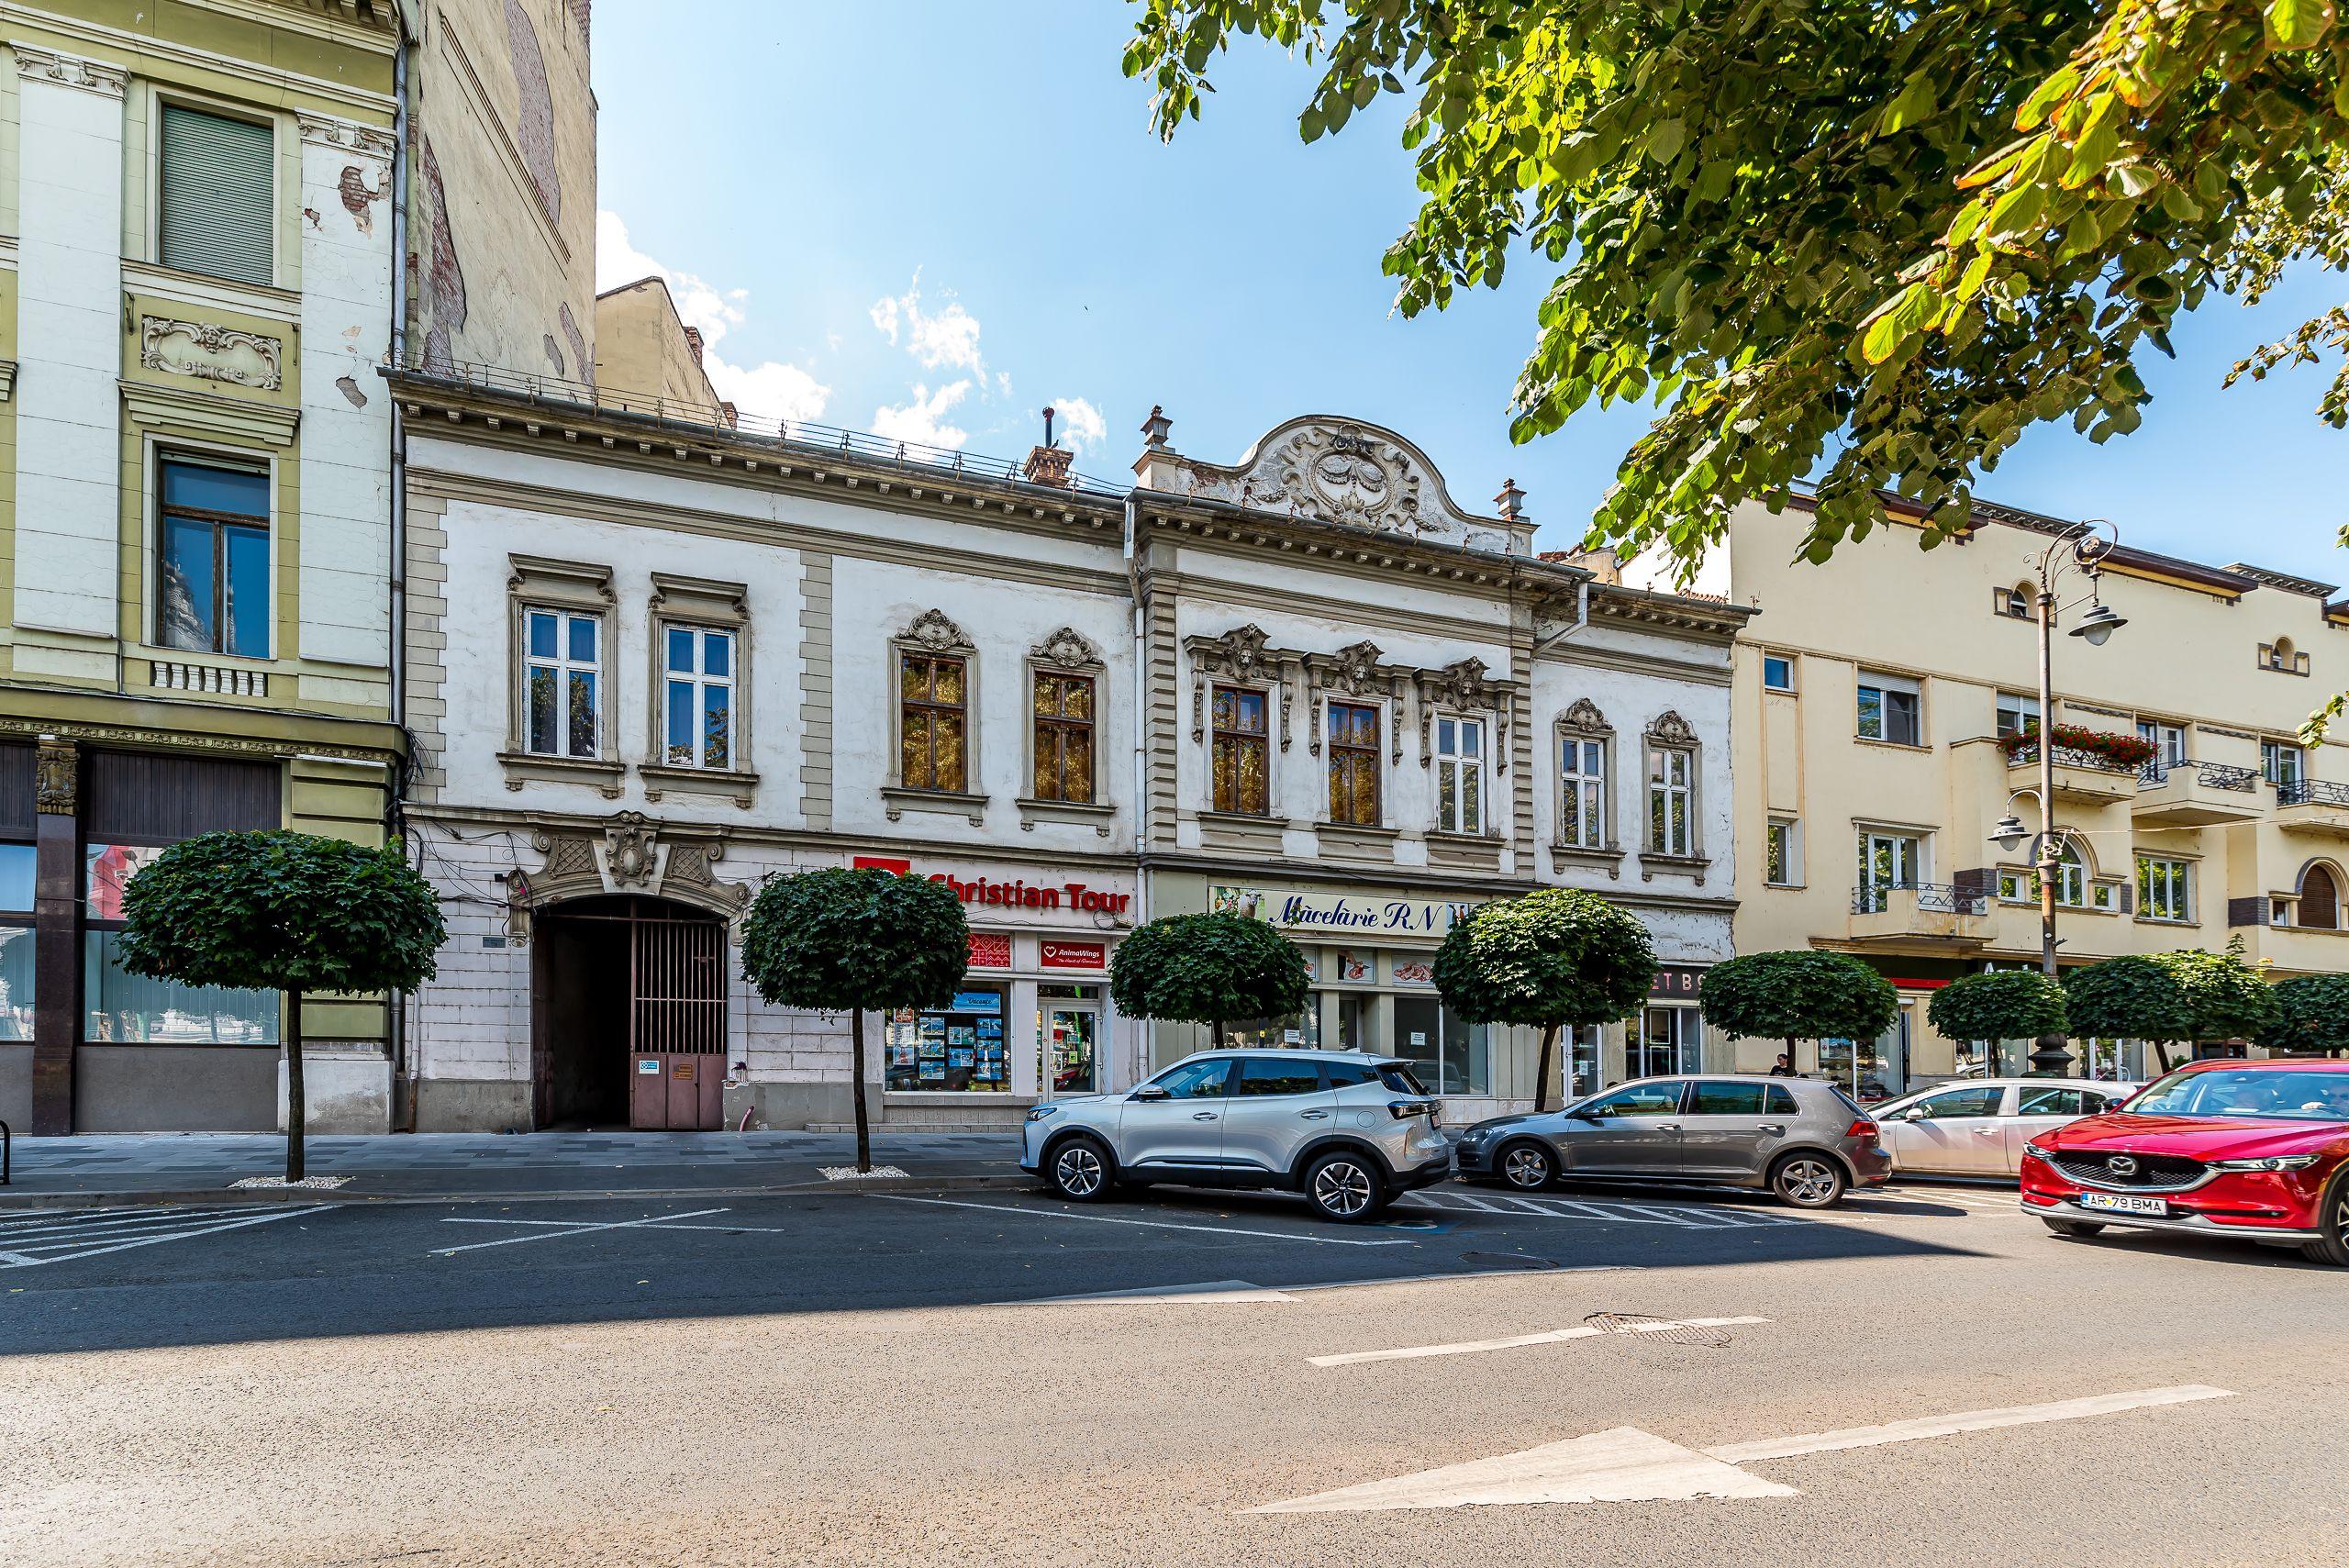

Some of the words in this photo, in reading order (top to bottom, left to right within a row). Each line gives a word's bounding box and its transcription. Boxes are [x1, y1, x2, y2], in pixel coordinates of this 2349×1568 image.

[1063, 884, 1130, 913] Tour
[1058, 949, 1100, 959] AnimaWings
[2090, 1195, 2107, 1206] AR
[2111, 1196, 2128, 1208] 79
[2132, 1198, 2162, 1212] BMA
